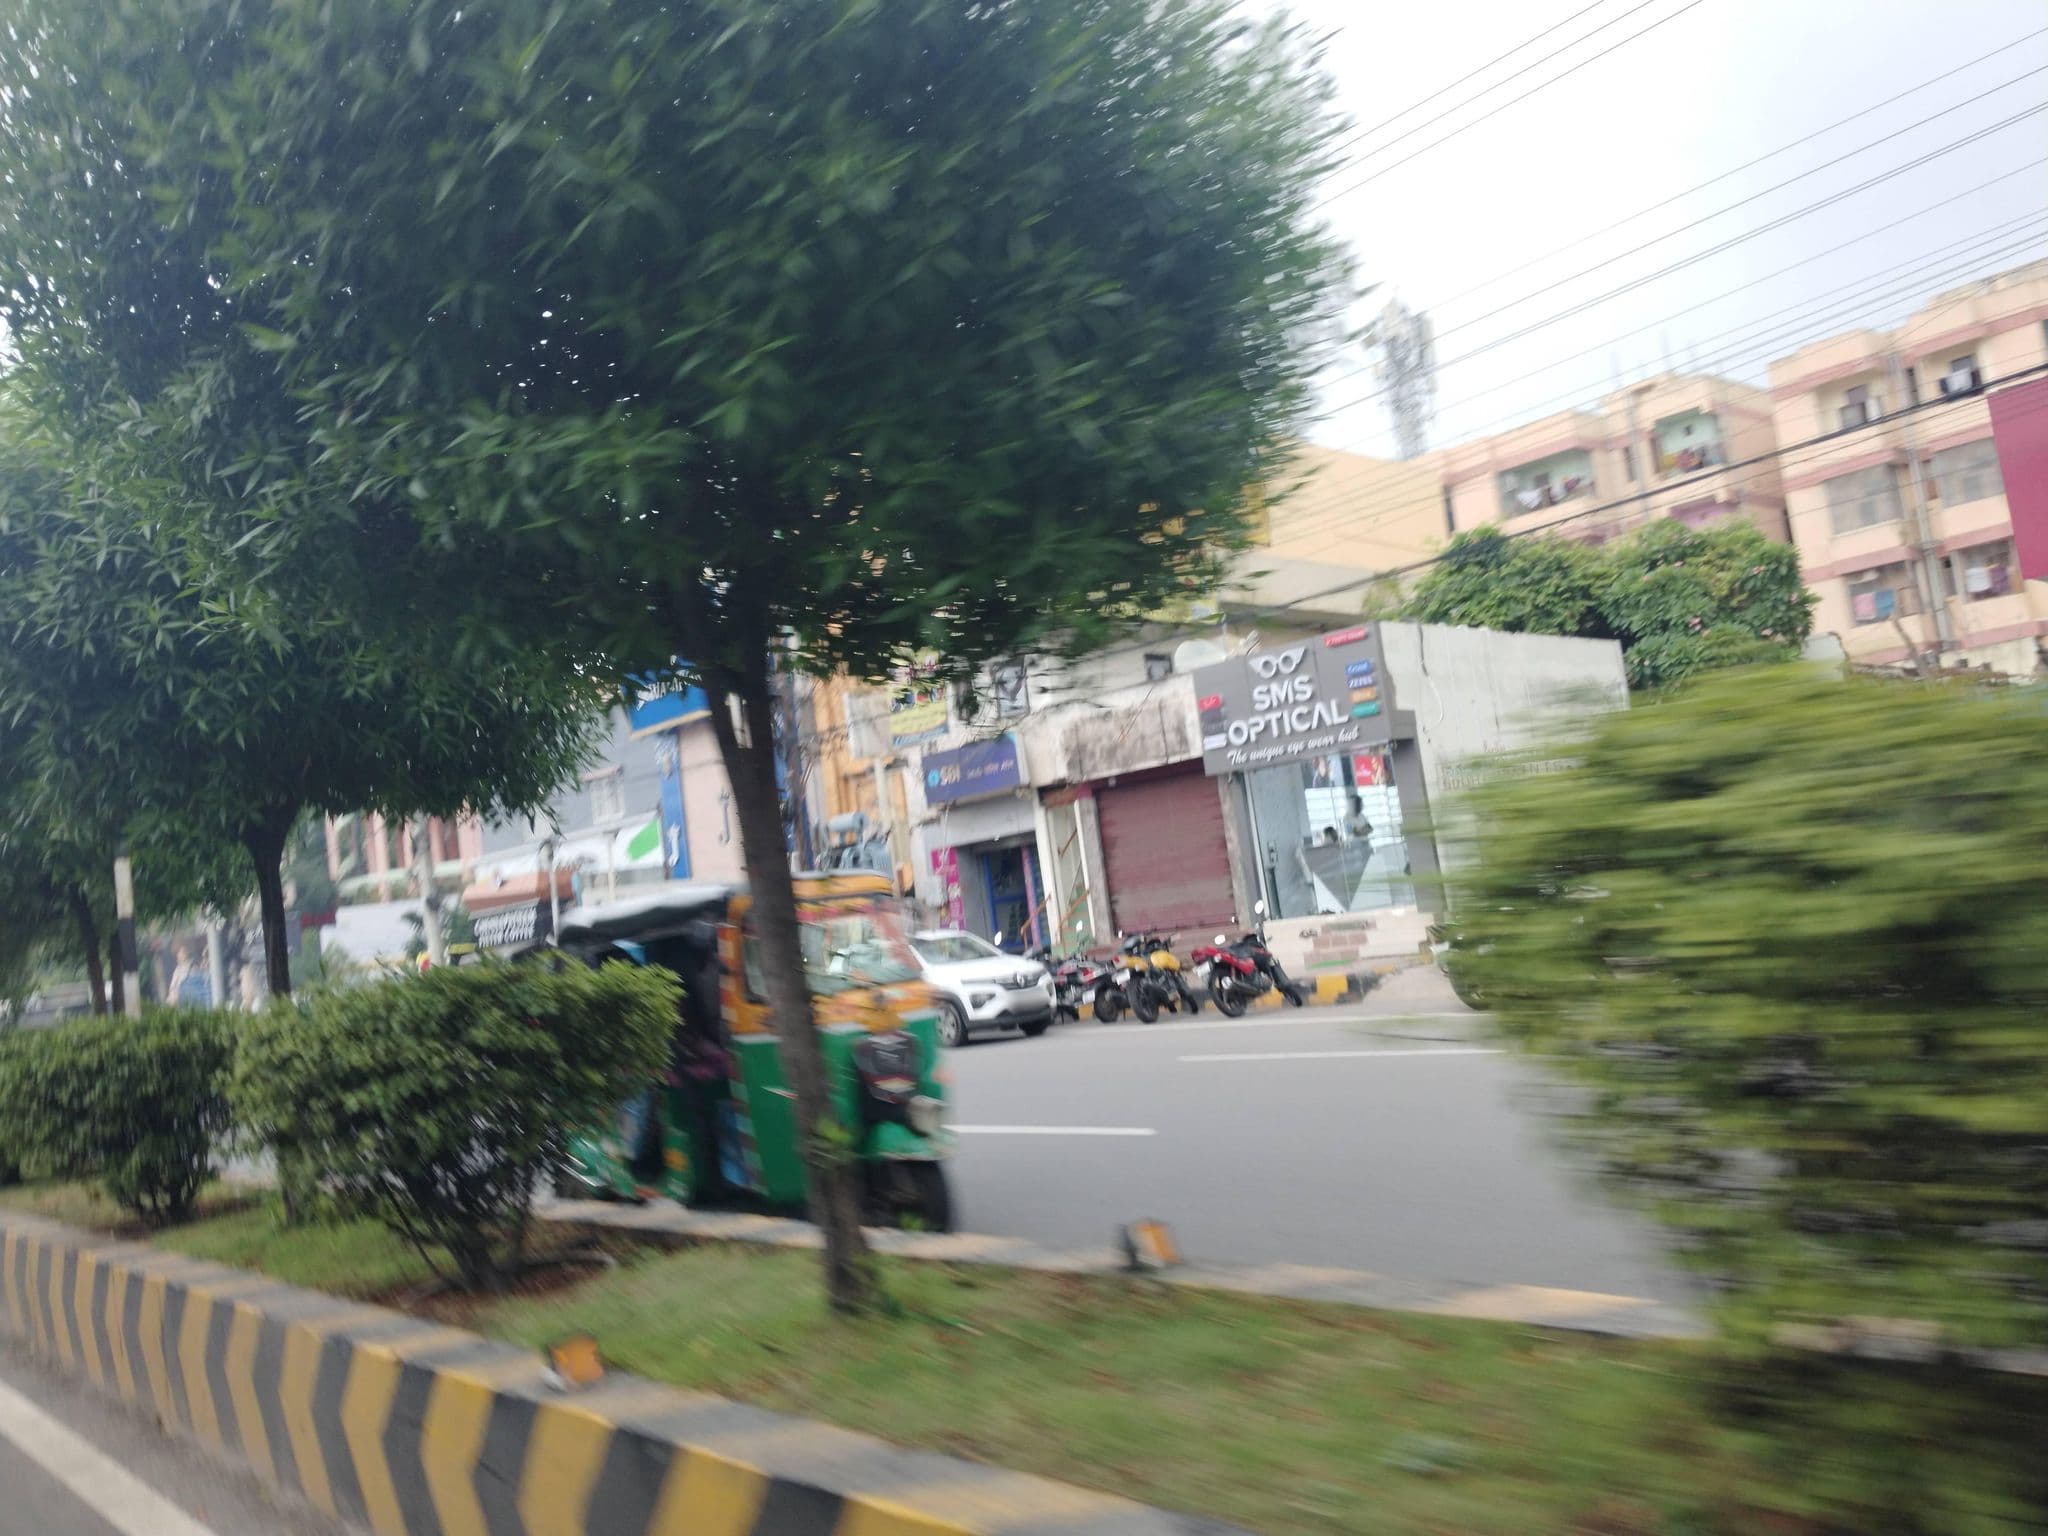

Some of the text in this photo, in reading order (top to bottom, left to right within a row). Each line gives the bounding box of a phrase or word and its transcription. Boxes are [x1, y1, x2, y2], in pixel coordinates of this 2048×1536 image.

[1253, 675, 1313, 712] SMS
[1228, 699, 1350, 746] OPTICAL
[1227, 725, 1361, 766] The unique eye wear hub
